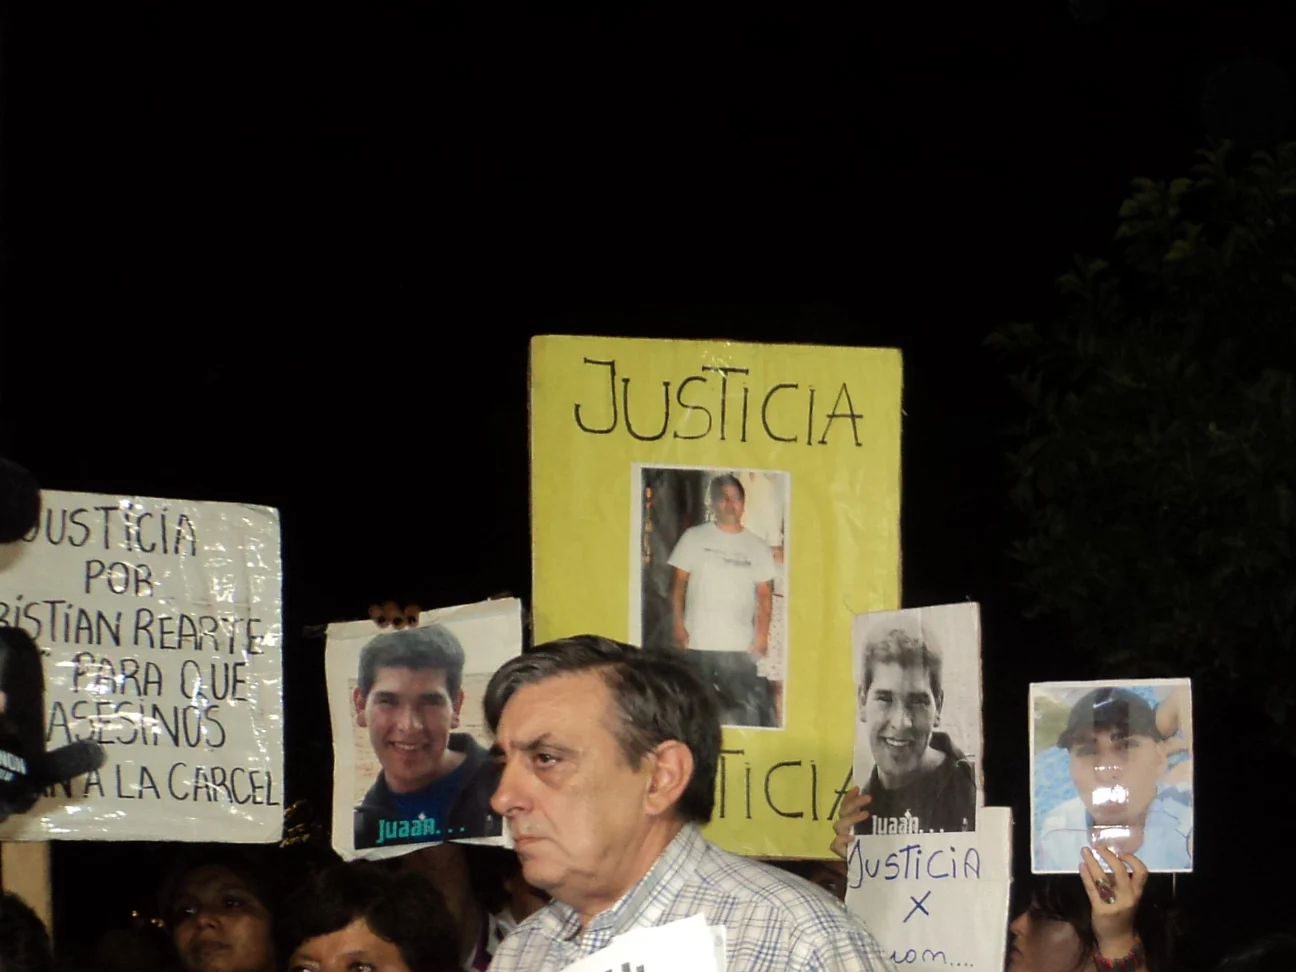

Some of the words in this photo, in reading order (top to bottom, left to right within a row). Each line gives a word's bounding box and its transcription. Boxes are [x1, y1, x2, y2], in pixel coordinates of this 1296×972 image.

[573, 356, 864, 447] JUSTICIA
[83, 558, 155, 598] POR
[133, 606, 266, 656] REARTE
[71, 651, 163, 697] PARA
[180, 659, 249, 701] QUE
[46, 699, 226, 748] ASESINOS
[116, 763, 161, 800] LA
[168, 761, 281, 806] CARCEL
